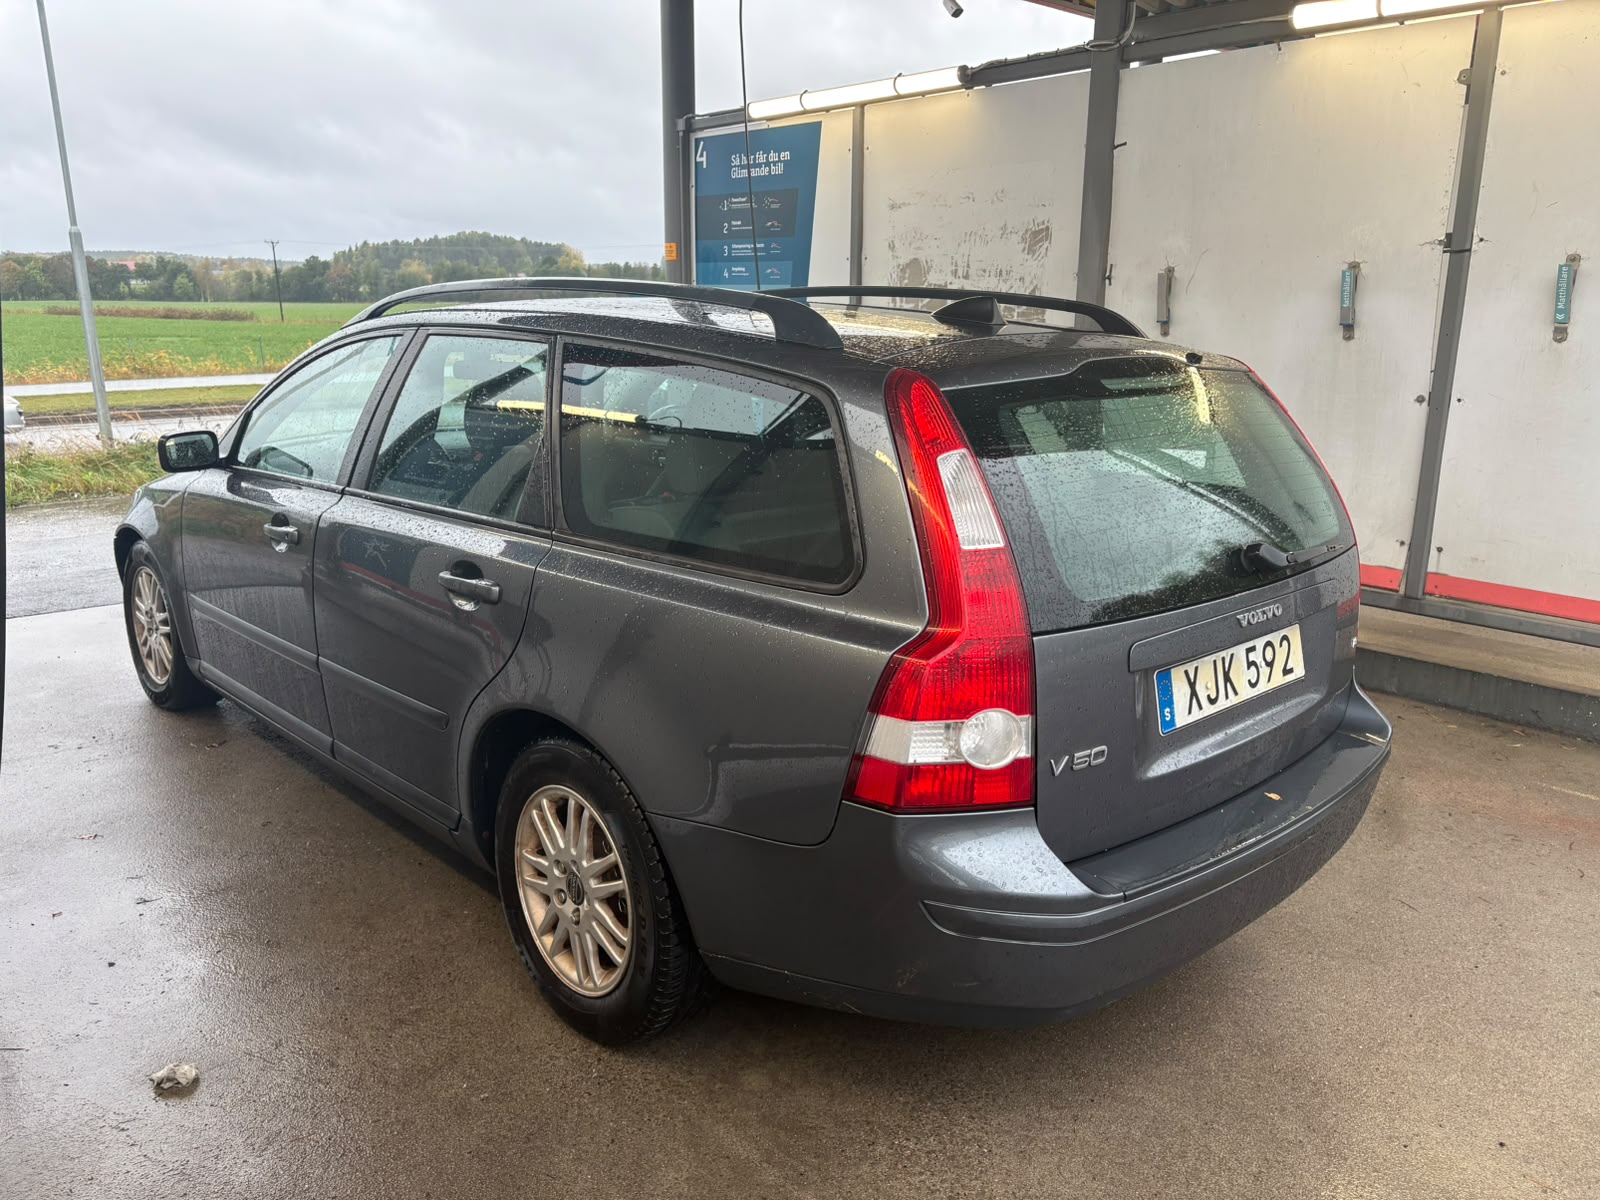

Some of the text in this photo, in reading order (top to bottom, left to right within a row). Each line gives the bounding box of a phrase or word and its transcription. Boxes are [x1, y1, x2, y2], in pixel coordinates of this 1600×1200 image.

[696, 141, 706, 169] 4
[731, 153, 740, 166] Så
[755, 150, 767, 163] får
[769, 150, 779, 162] du
[780, 151, 790, 160] en
[731, 162, 784, 179] Glimande bil!
[723, 222, 728, 234] 2
[723, 245, 728, 257] 3
[723, 268, 729, 279] 4
[1557, 266, 1569, 309] Matthållare
[1236, 603, 1283, 627] VOLVO
[1184, 634, 1294, 715] XJK 592
[1164, 707, 1171, 721] S
